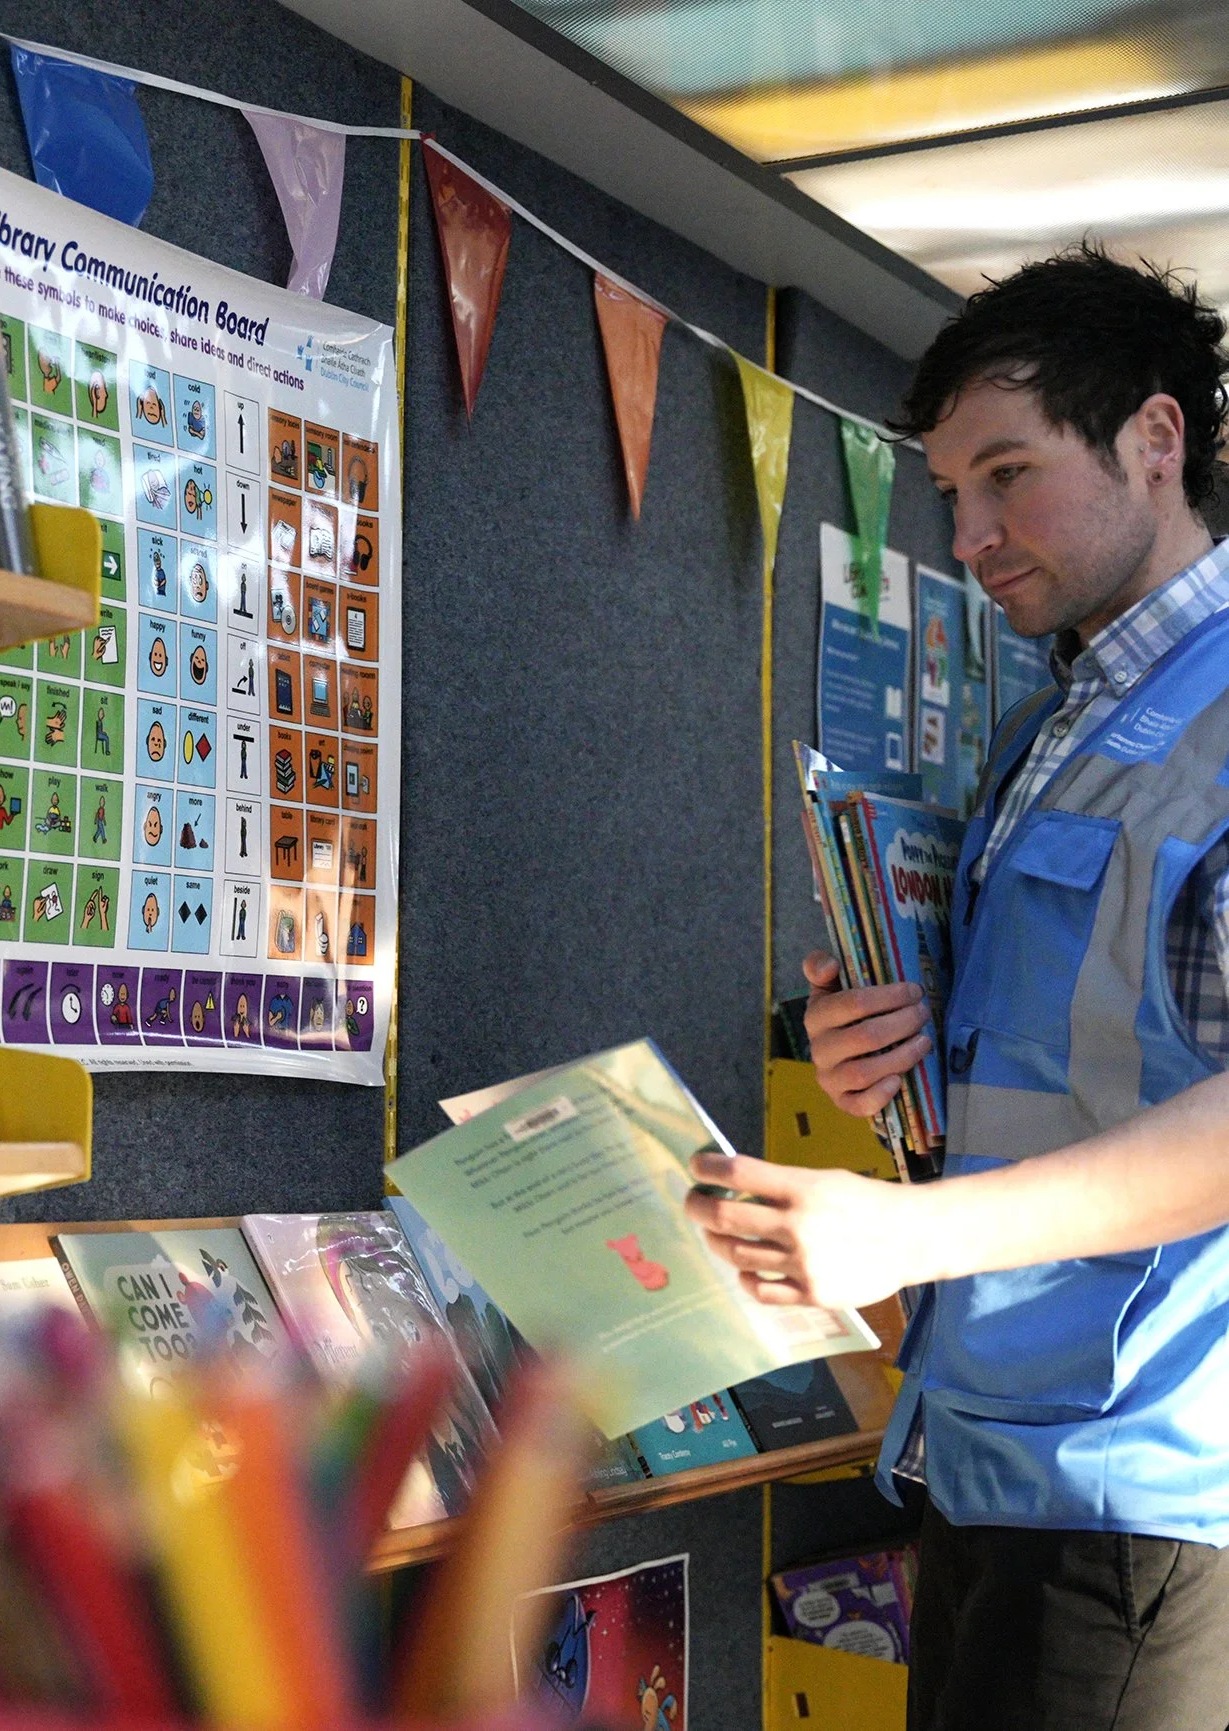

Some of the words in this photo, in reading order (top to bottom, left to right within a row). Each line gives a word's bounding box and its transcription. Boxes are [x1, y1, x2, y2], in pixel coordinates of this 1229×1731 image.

[61, 241, 209, 325] Communication
[215, 301, 269, 346] Board
[5, 264, 34, 291] these
[38, 280, 81, 308] symbols
[84, 295, 96, 313] to
[99, 304, 125, 325] make
[171, 328, 198, 350] share
[201, 337, 225, 360] ideas
[228, 352, 244, 368] and
[247, 356, 272, 378] direct
[274, 368, 304, 391] actions
[188, 384, 200, 393] cold
[237, 402, 245, 410] up
[194, 465, 203, 475] hot
[236, 480, 250, 490] down
[152, 536, 163, 546] sick
[150, 620, 166, 633] happy
[192, 629, 206, 642] funny
[47, 685, 70, 698] finished
[100, 697, 108, 705] sit
[152, 706, 163, 715] sad
[188, 712, 209, 724] different
[237, 723, 251, 732] under
[48, 776, 61, 788] play
[95, 783, 108, 793] walk
[147, 791, 162, 803] angry
[189, 798, 203, 807] more
[236, 803, 252, 814] behind
[43, 867, 59, 876] draw
[92, 871, 105, 882] sign
[145, 877, 158, 887] quiet
[186, 881, 201, 890] same
[891, 864, 942, 906] LONDON
[234, 885, 251, 895] beside
[66, 968, 80, 976] later
[58, 1260, 83, 1294] OWEN
[117, 1273, 162, 1301] CAN
[160, 1273, 172, 1299] I
[128, 1302, 190, 1331] COME
[138, 1332, 196, 1364] TOO?
